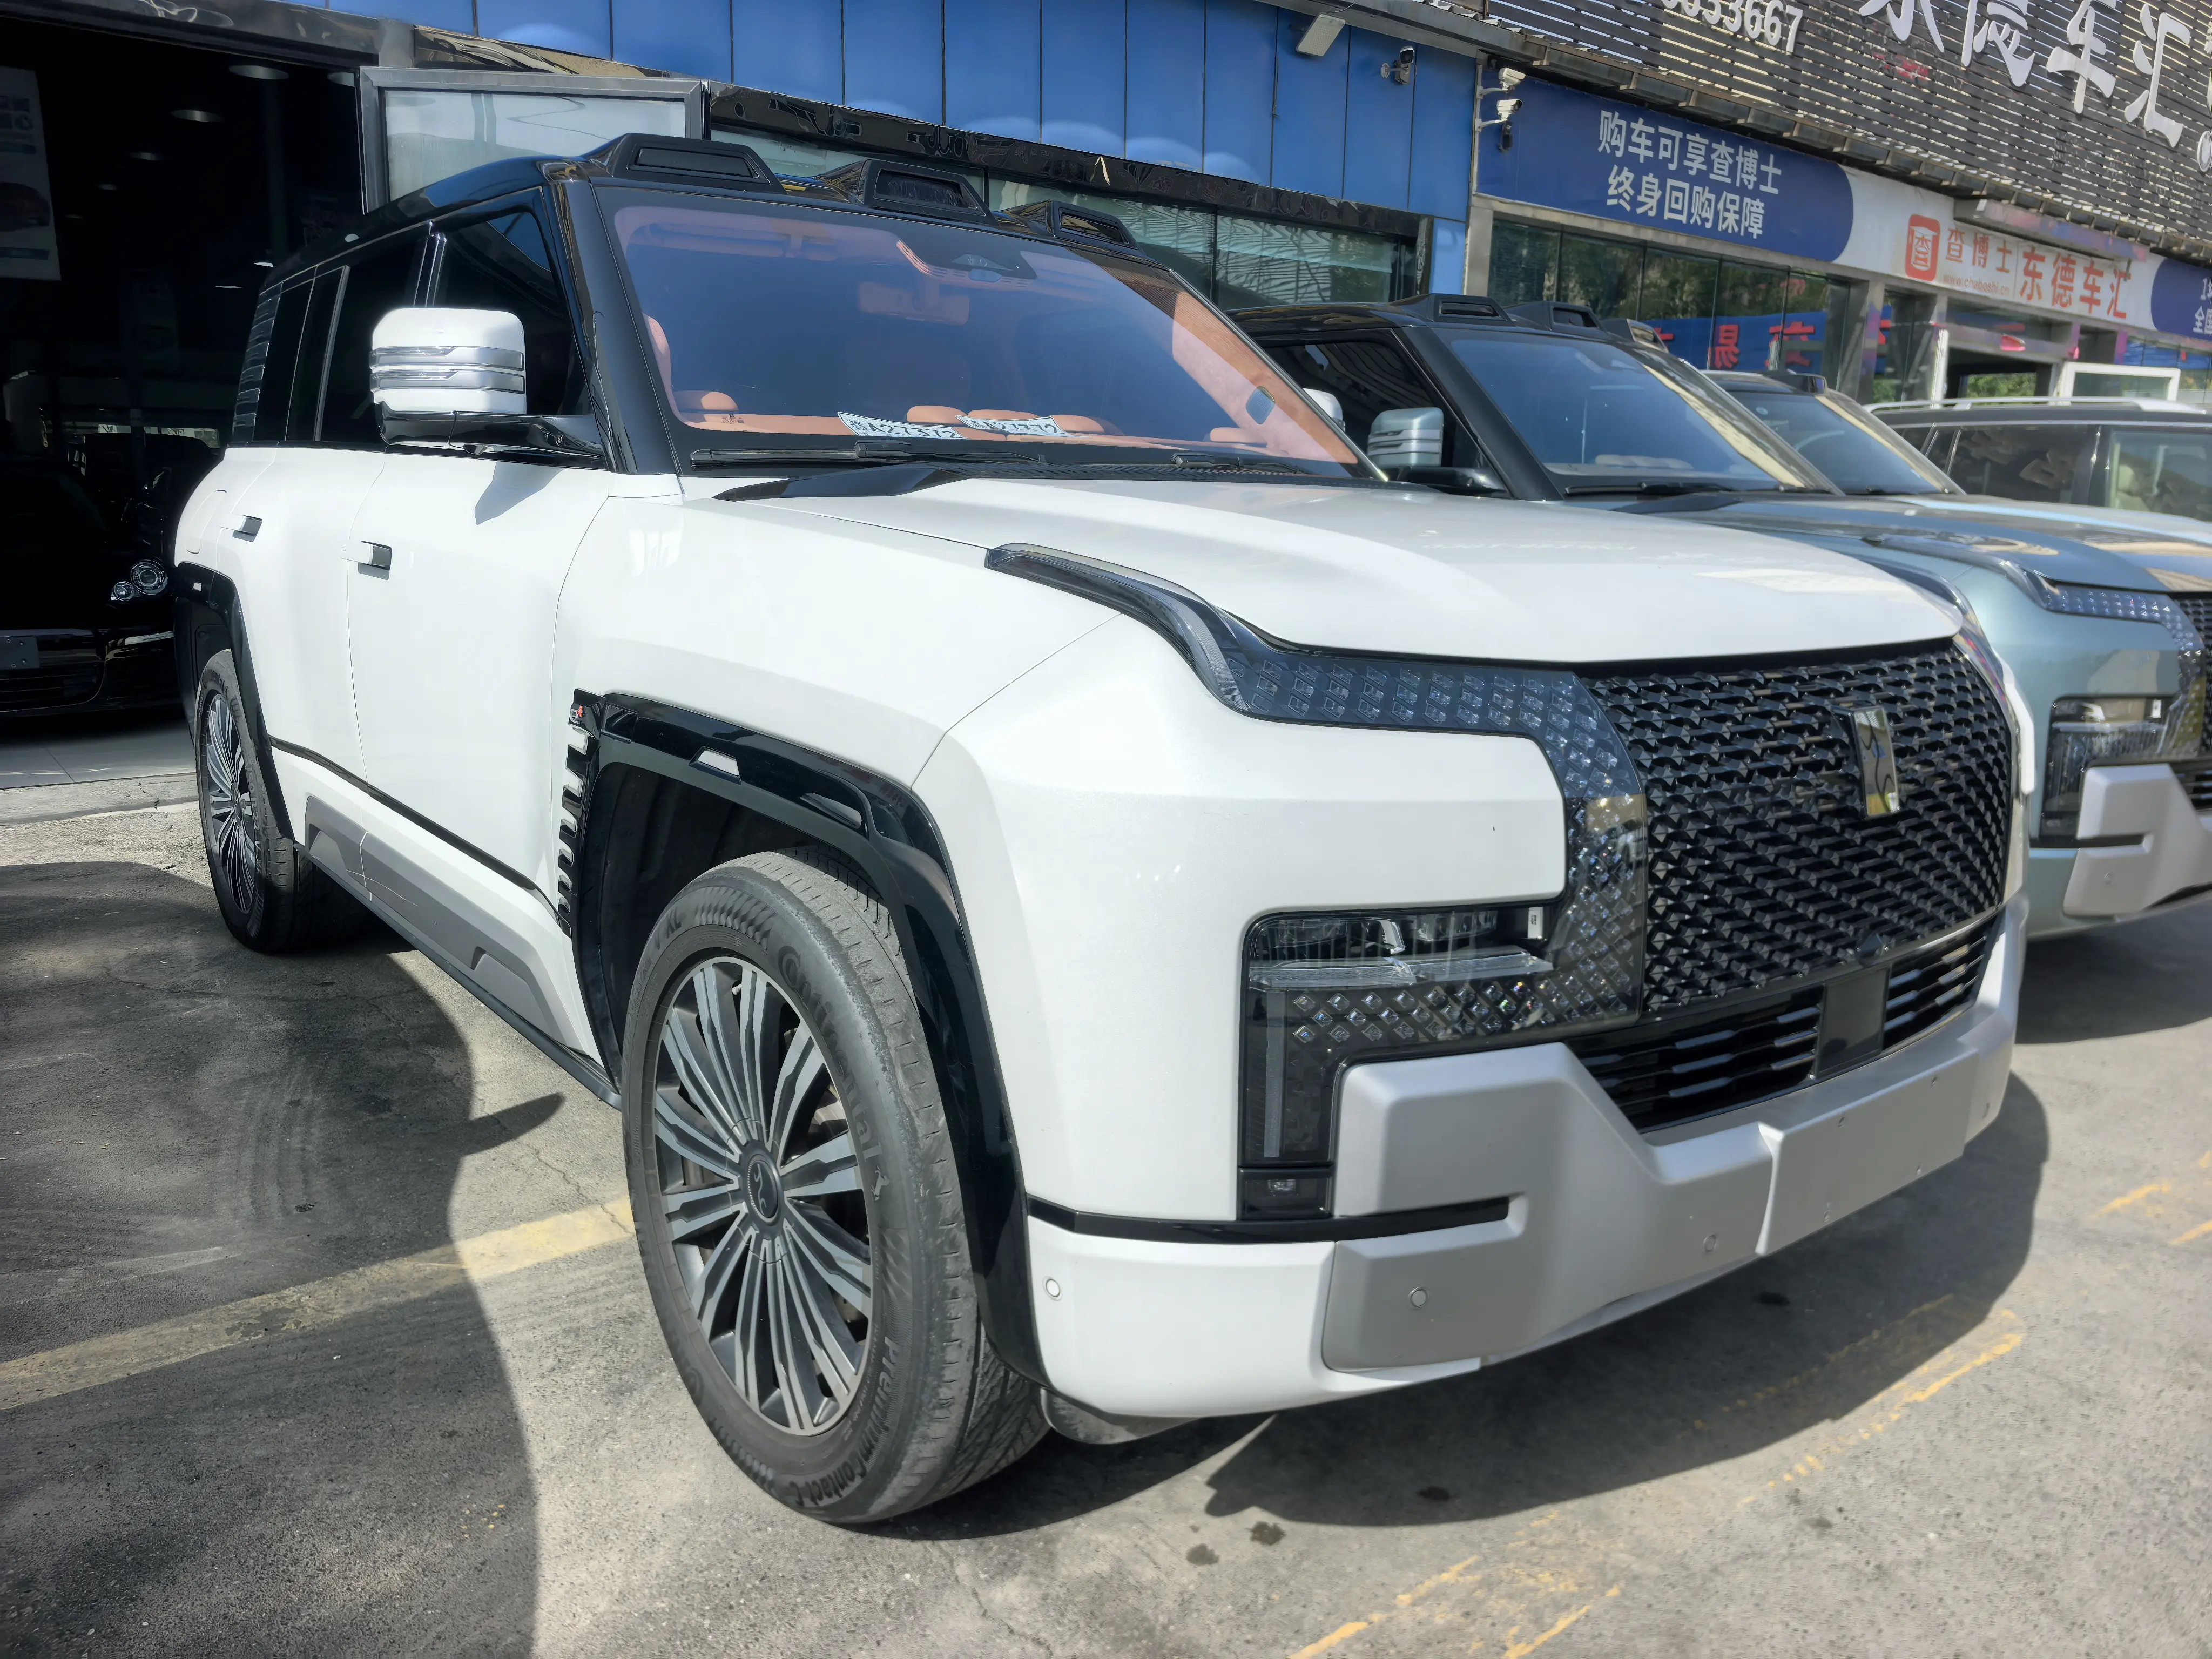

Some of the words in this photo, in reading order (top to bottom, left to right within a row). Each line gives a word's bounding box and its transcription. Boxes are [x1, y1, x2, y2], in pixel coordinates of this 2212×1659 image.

[1598, 110, 1782, 195] 购车可享查博士
[1607, 165, 1764, 239] 终身回购保障
[1945, 227, 2012, 273] 查博士
[2019, 245, 2131, 319] 东德车汇
[778, 945, 883, 1160] Continental
